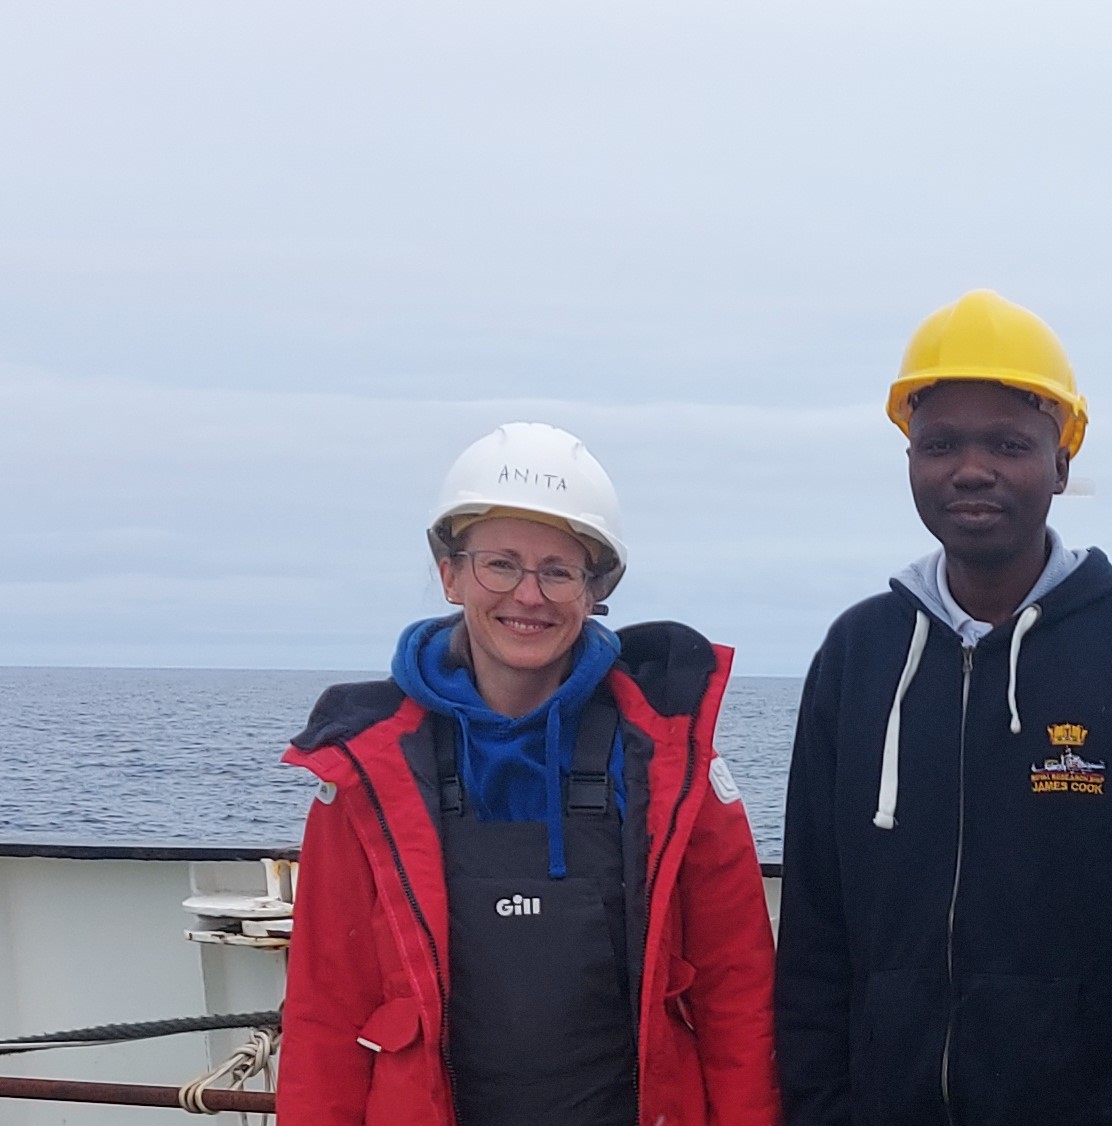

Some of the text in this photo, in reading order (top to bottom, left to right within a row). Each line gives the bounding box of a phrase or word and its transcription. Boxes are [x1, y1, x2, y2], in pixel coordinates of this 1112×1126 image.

[498, 465, 568, 491] ANITA
[1032, 781, 1104, 795] JAMES COOK
[495, 894, 541, 917] Gill
